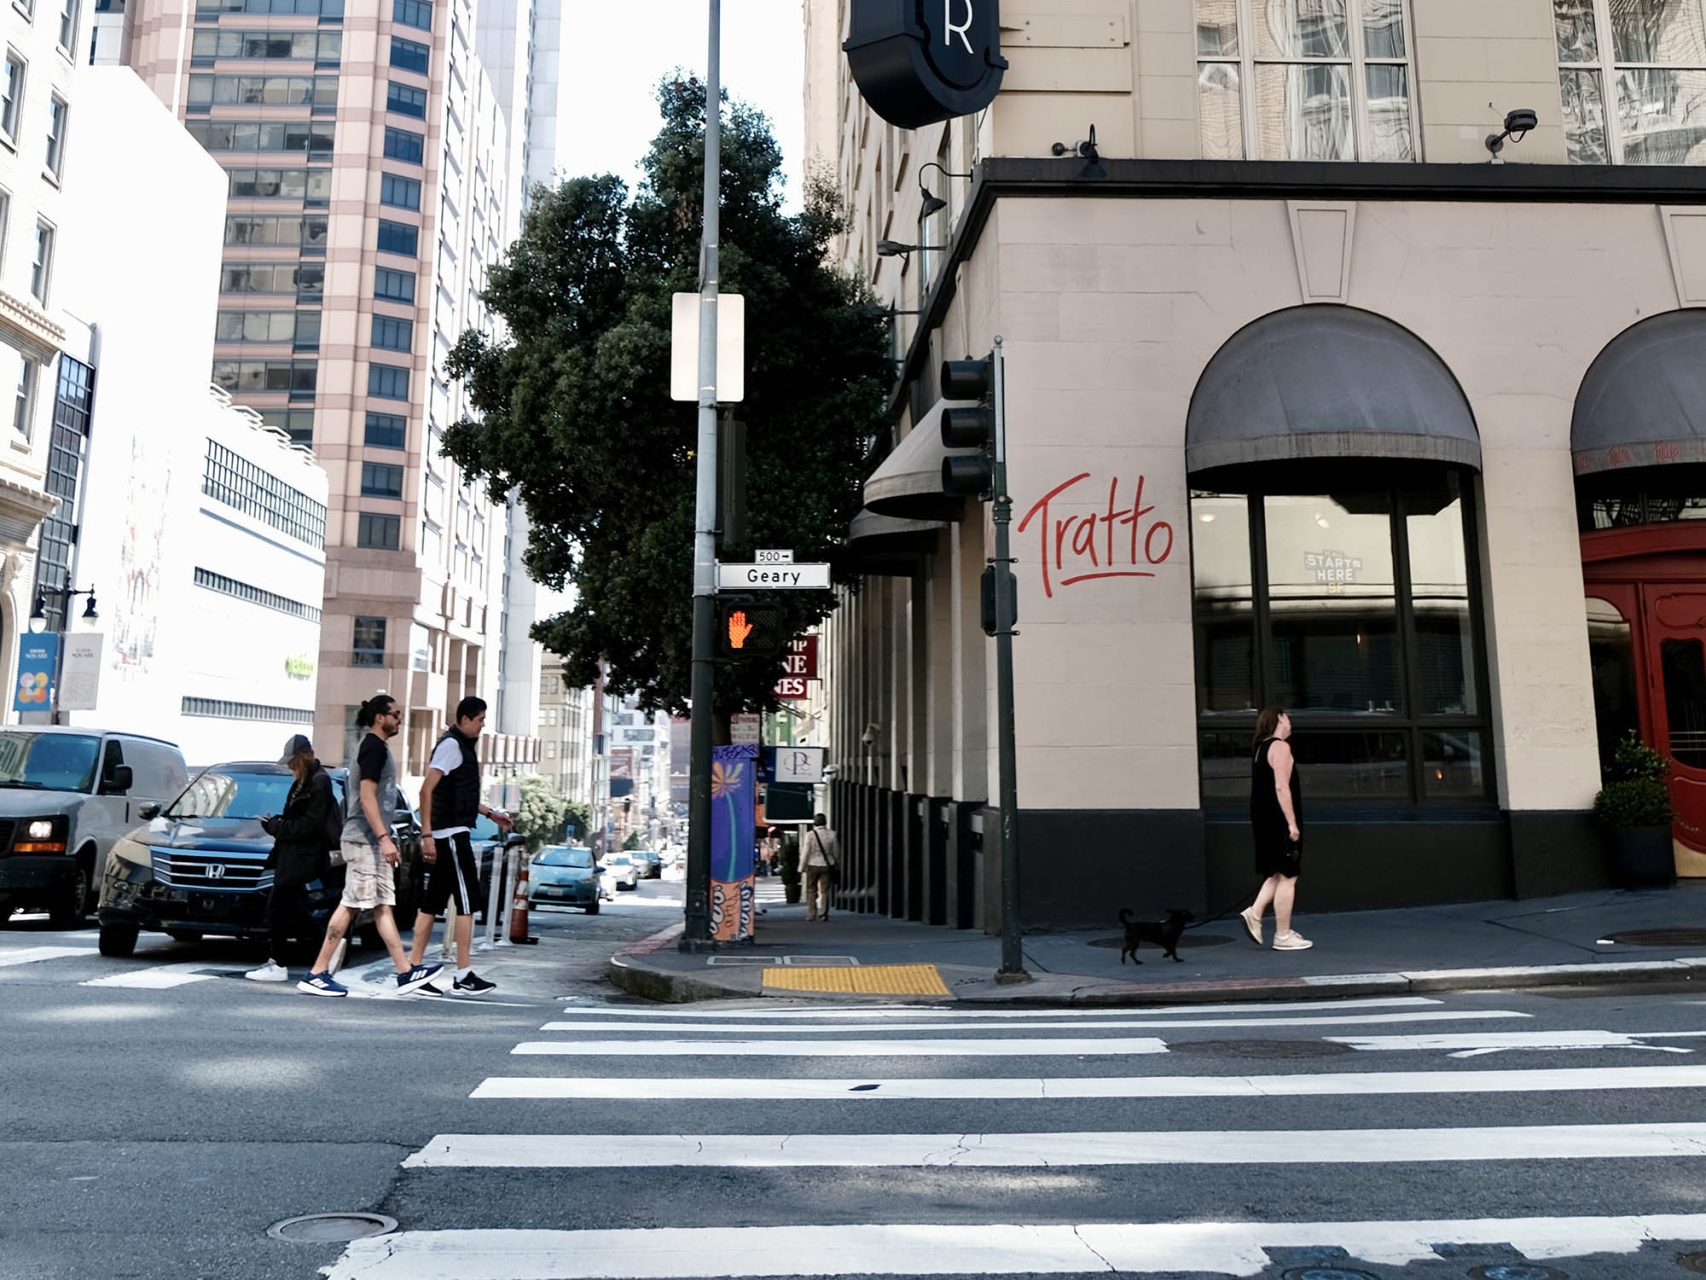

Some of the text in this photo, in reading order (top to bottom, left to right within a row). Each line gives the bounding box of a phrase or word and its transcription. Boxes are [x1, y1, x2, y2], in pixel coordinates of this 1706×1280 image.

[1018, 472, 1173, 598] Tratto
[759, 551, 780, 561] 500
[1305, 554, 1361, 569] STARTS
[747, 569, 801, 586] Geary
[1317, 568, 1353, 581] HERE
[773, 678, 805, 696] NES
